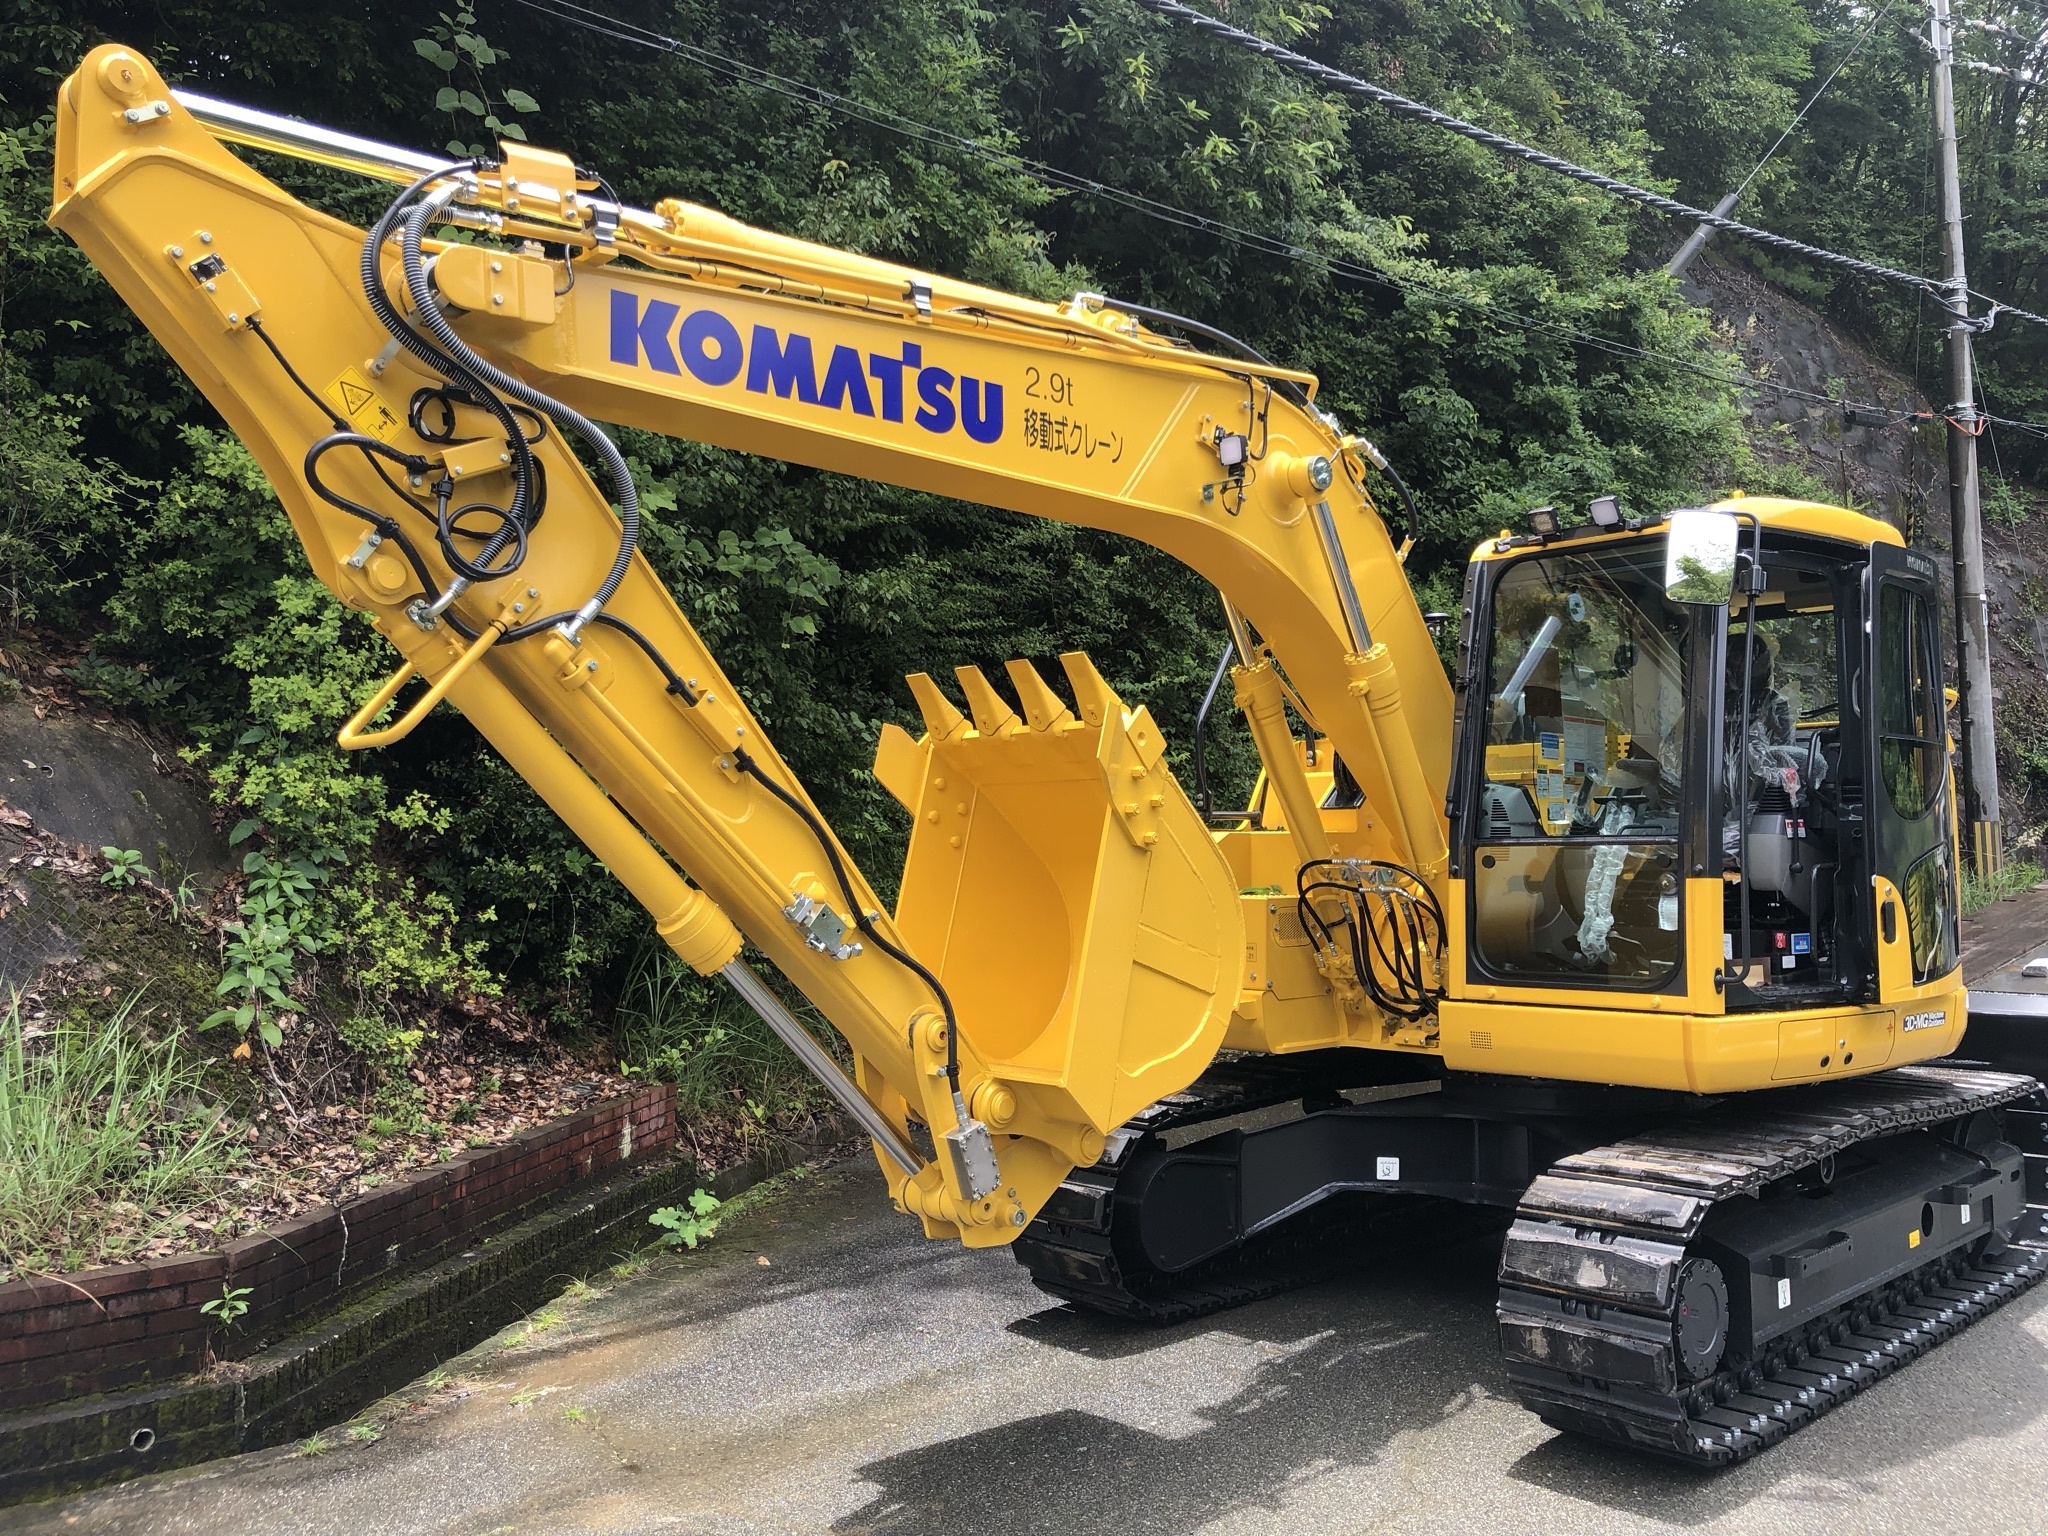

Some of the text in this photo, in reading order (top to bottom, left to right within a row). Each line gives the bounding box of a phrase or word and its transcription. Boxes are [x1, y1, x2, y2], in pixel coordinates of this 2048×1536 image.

[610, 290, 1003, 444] KOMATSU
[1025, 366, 1074, 407] 2.9t
[1023, 407, 1123, 464] 移動式クレーン
